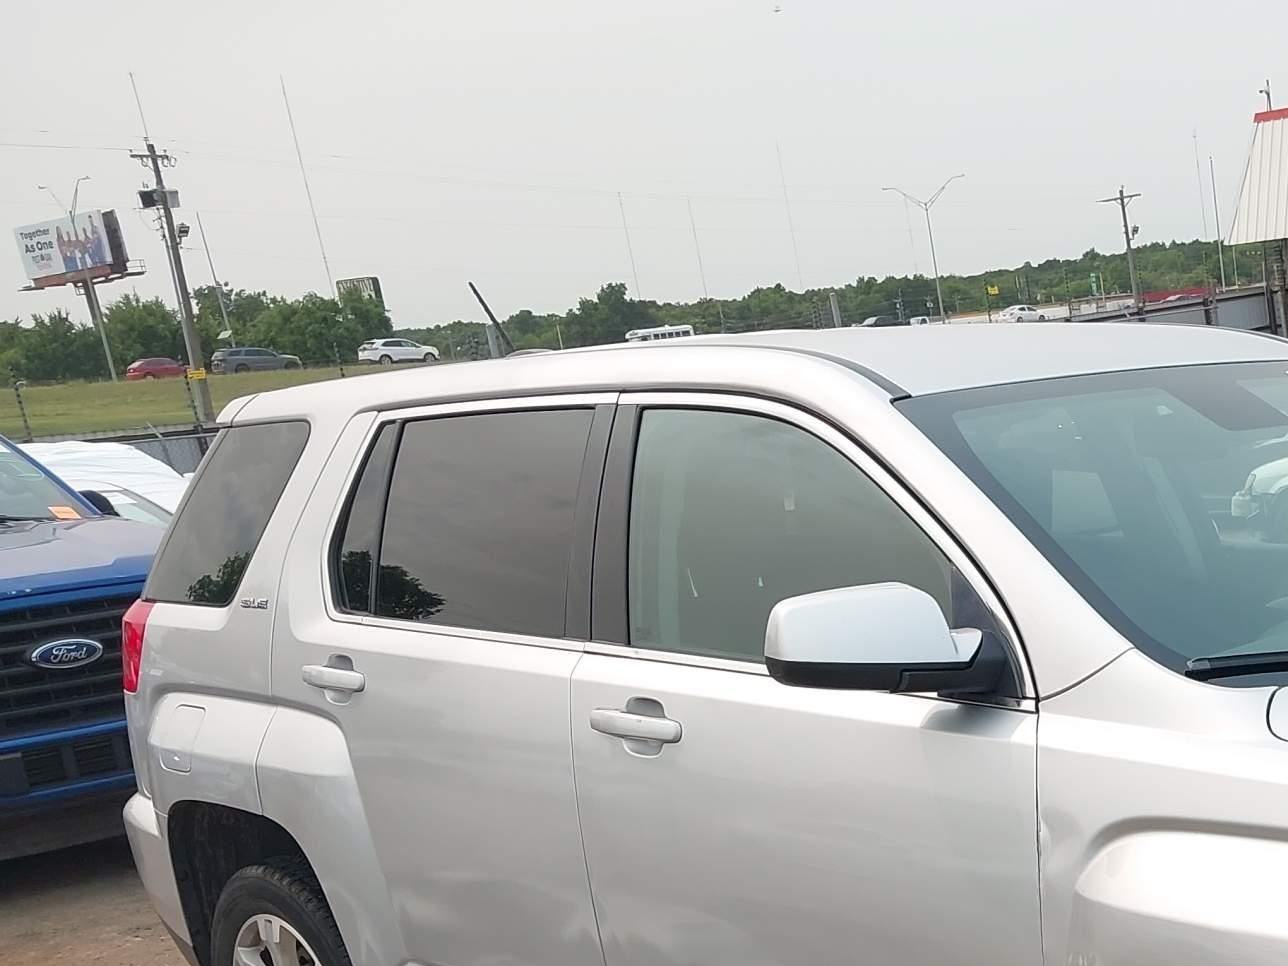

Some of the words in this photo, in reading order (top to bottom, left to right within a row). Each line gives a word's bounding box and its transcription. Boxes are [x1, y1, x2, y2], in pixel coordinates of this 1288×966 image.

[24, 243, 36, 254] As
[36, 240, 54, 252] One
[240, 598, 269, 610] SLE
[50, 644, 88, 663] Ford
